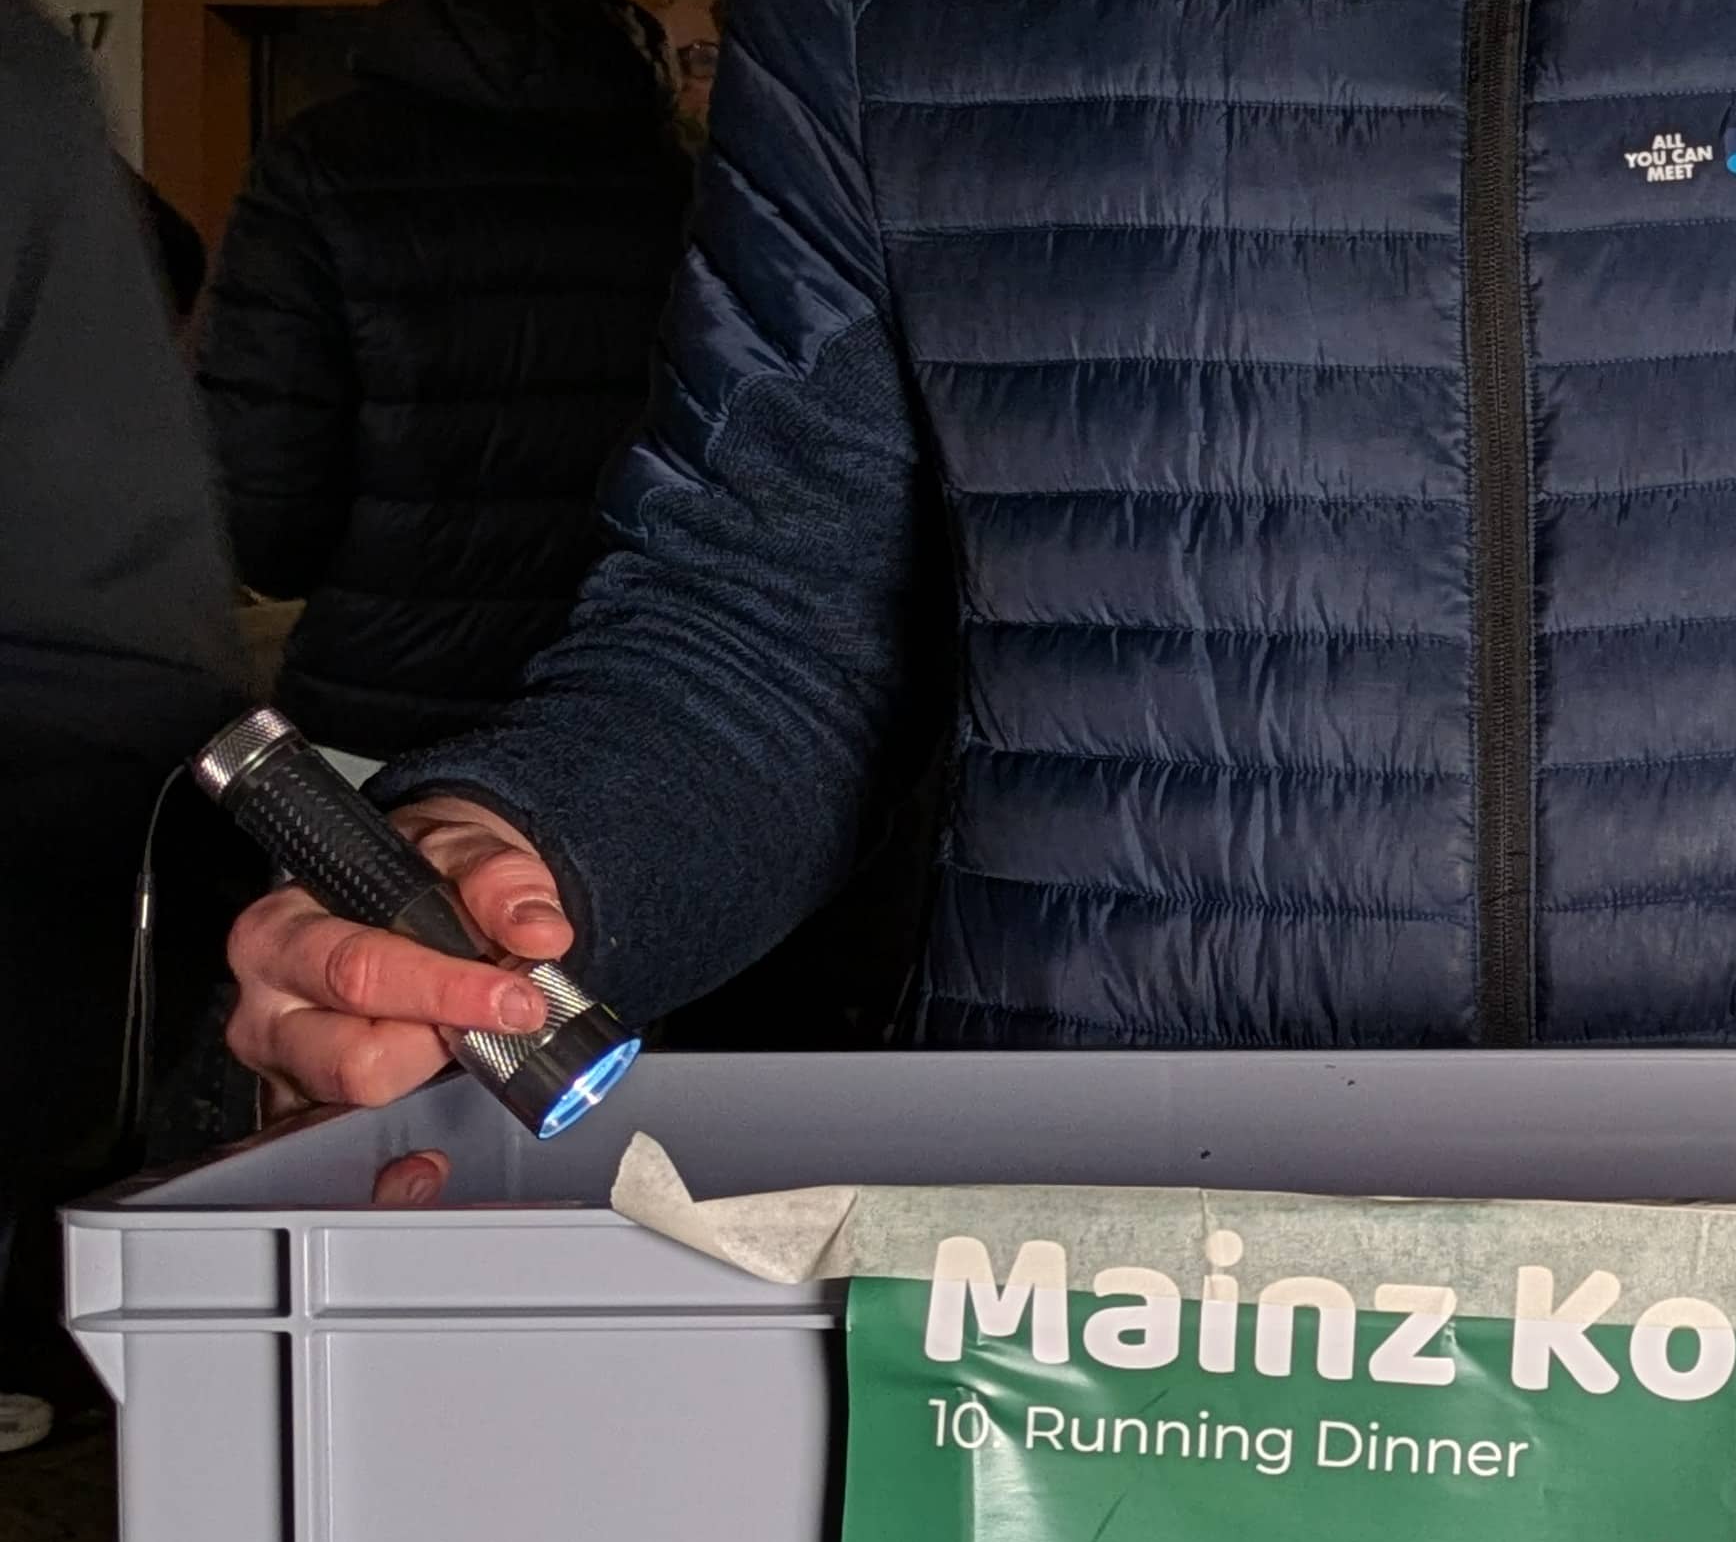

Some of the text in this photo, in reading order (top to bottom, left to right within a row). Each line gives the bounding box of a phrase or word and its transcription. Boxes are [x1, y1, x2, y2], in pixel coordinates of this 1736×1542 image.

[1652, 132, 1686, 150] ALL
[1624, 145, 1713, 169] YOU CAN
[1646, 163, 1694, 182] MEET
[924, 1229, 1457, 1386] Mainz
[928, 1397, 1529, 1478] 10. Running Dinner
